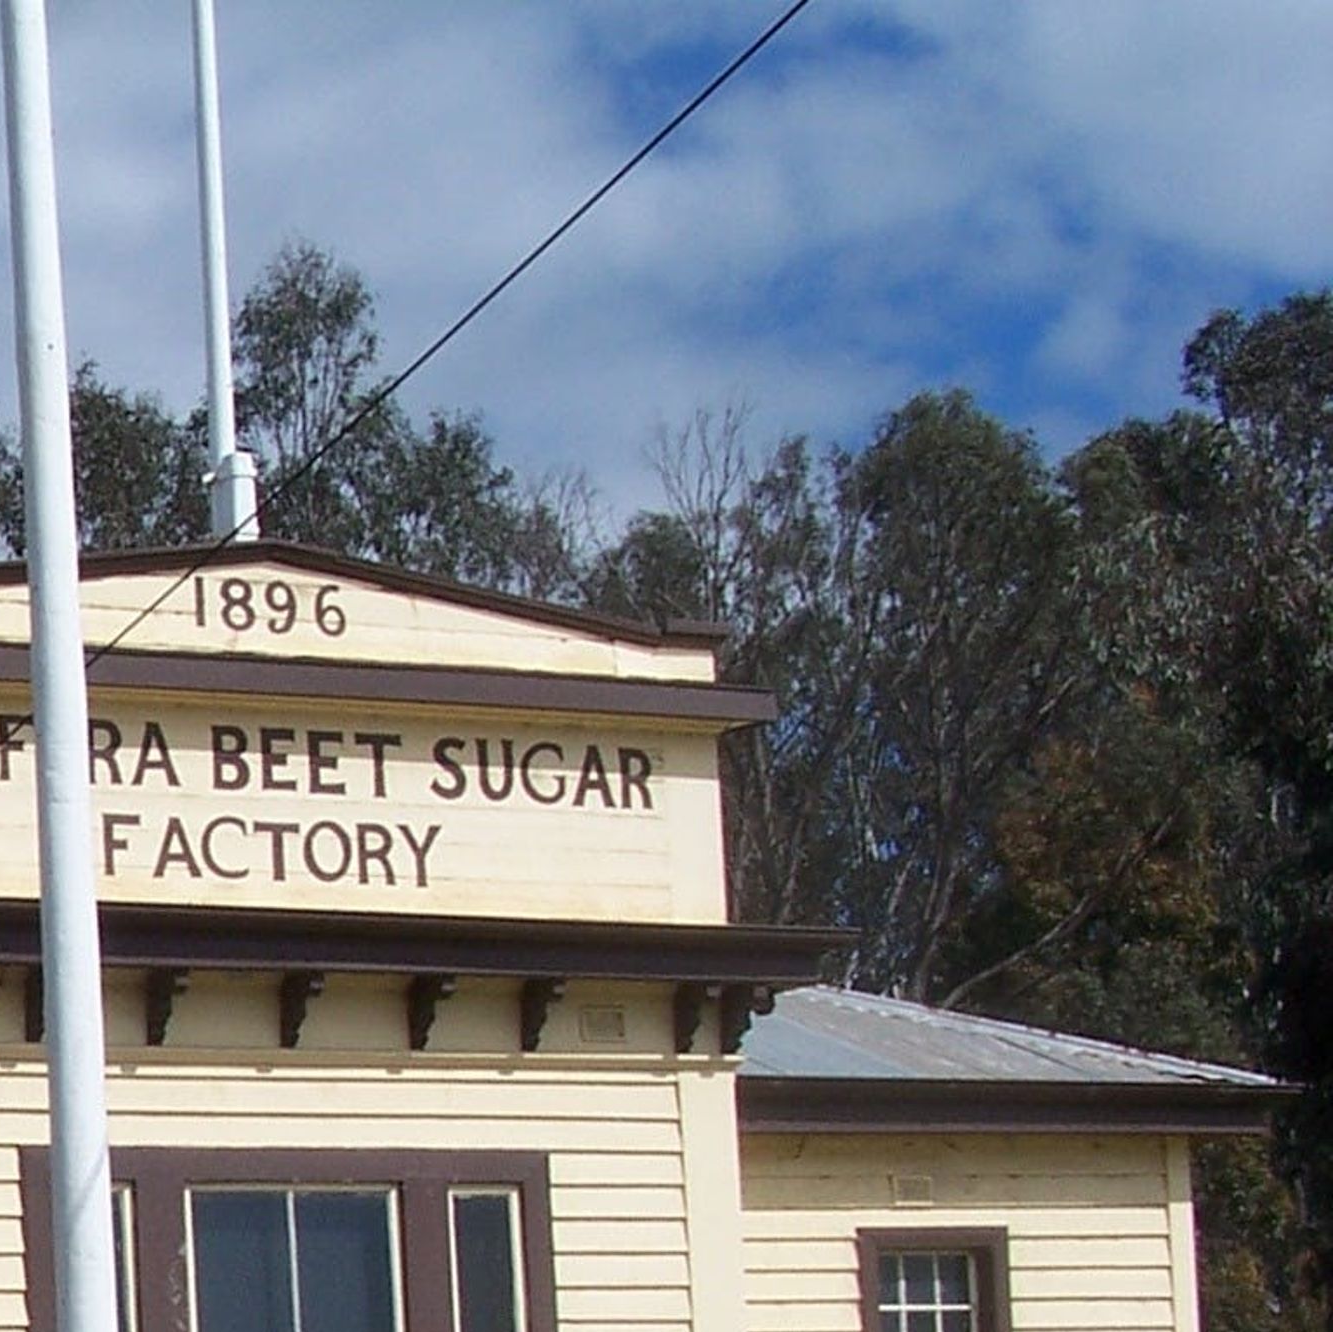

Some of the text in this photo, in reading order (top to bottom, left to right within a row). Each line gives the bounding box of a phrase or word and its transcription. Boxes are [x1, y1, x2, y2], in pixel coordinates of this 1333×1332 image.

[193, 576, 347, 637] 1896
[211, 725, 403, 798] BEET
[430, 737, 653, 809] SUGAR
[103, 813, 441, 886] FACTORY
